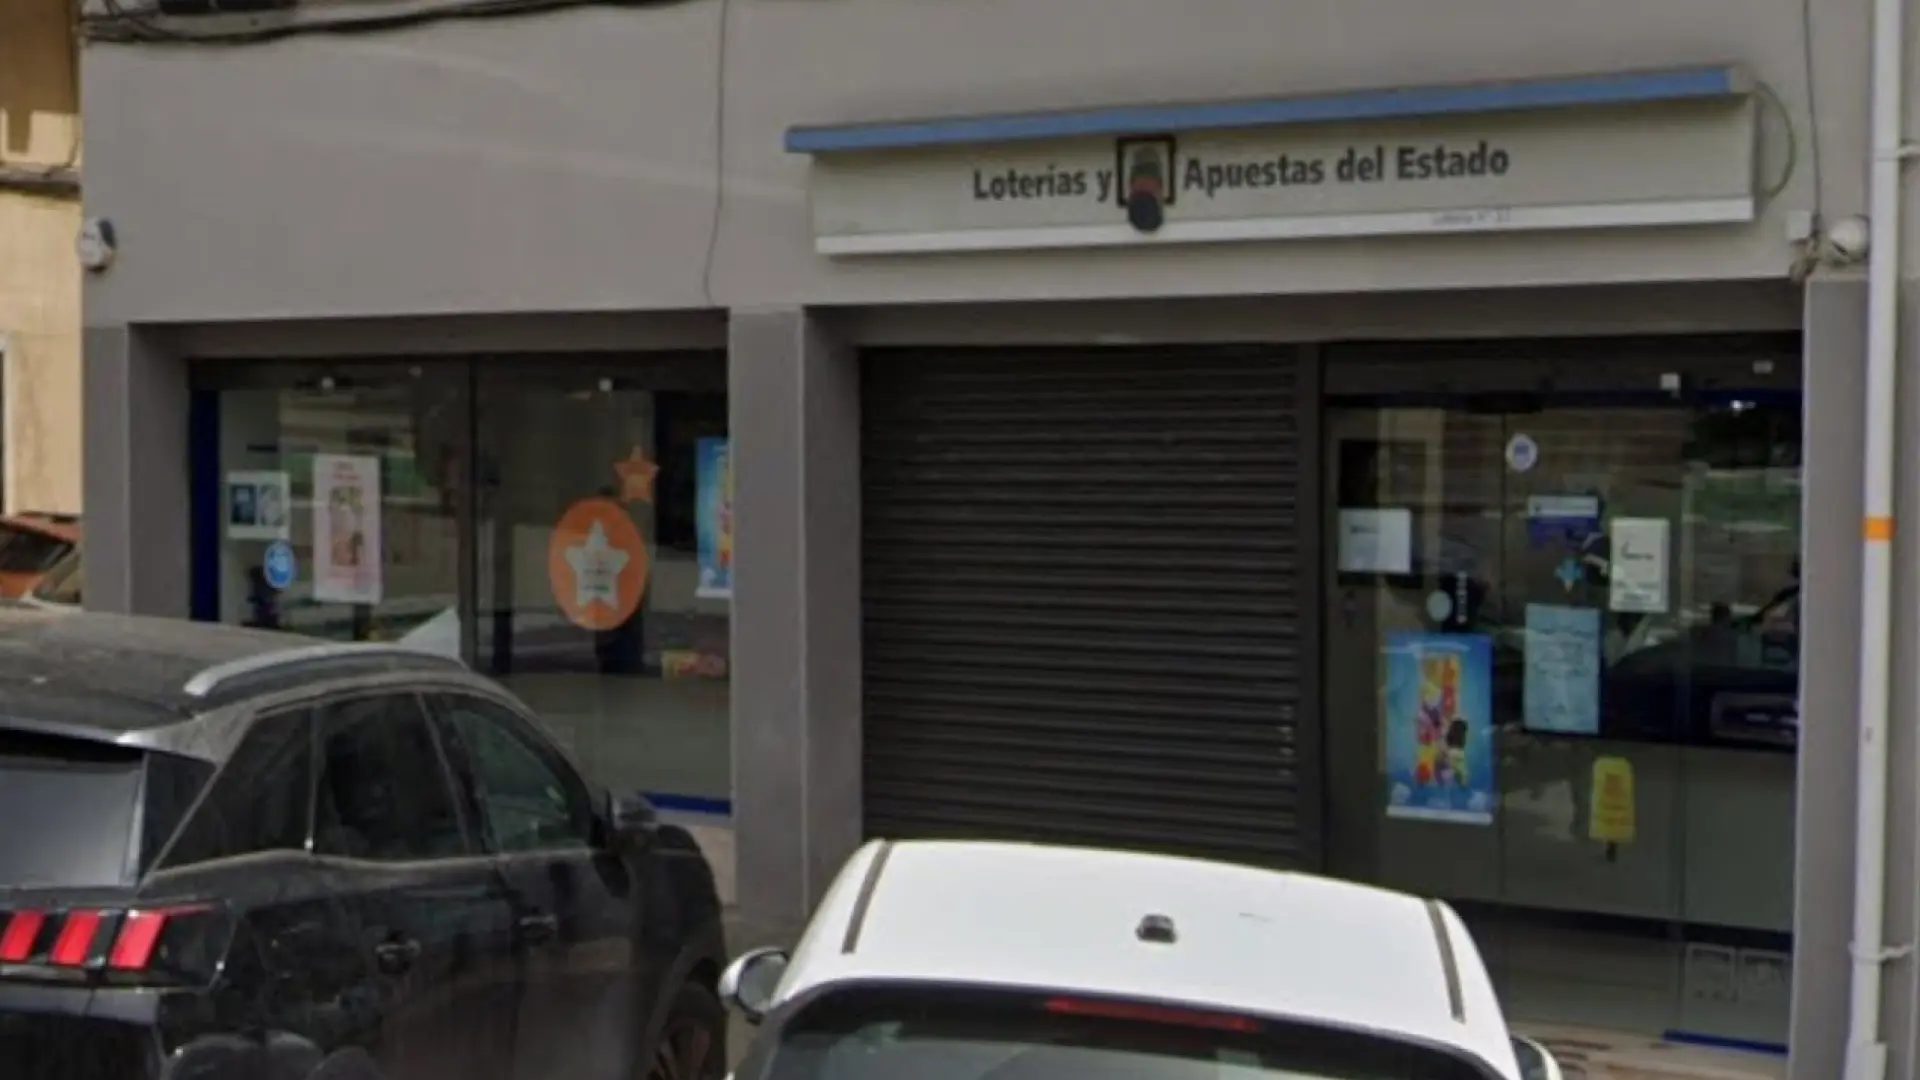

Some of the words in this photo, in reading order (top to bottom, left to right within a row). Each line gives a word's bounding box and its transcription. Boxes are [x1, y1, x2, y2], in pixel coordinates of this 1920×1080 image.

[1096, 170, 1113, 203] y
[1184, 155, 1325, 198] Apuestas
[1336, 145, 1384, 182] del
[1397, 139, 1510, 179] Estado
